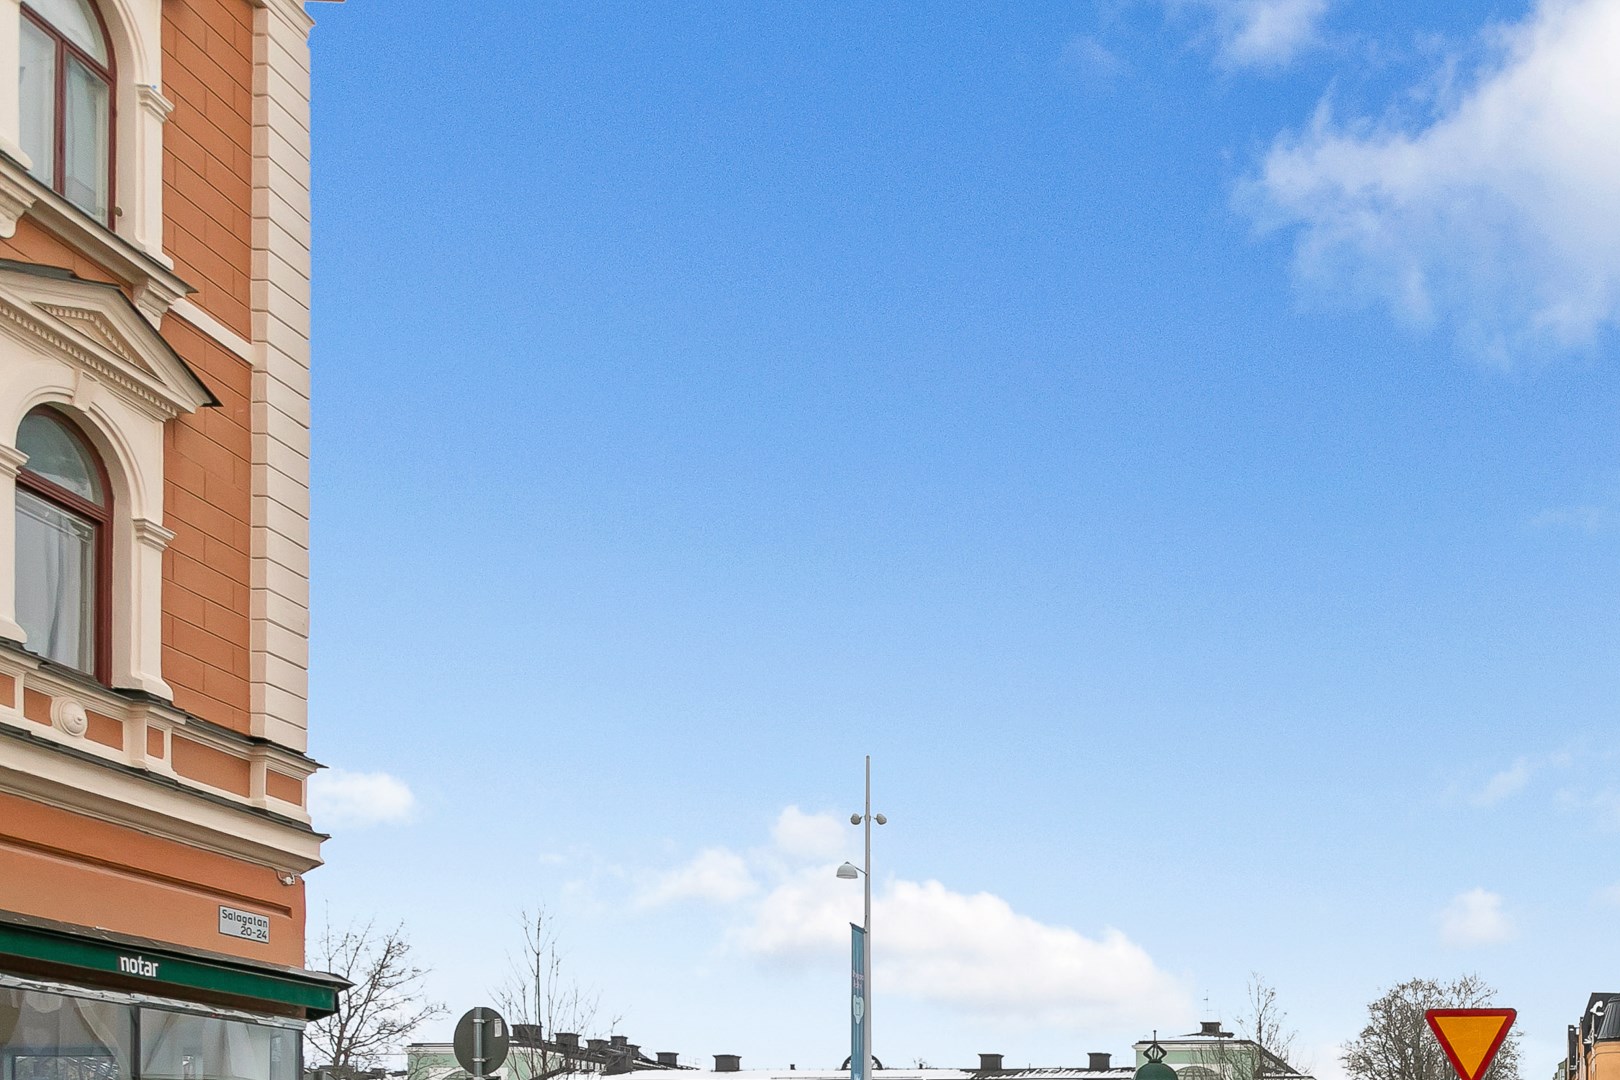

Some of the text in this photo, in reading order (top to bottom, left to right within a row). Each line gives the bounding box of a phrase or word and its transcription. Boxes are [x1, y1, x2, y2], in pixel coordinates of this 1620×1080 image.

[222, 909, 267, 928] Salagatan
[241, 925, 267, 940] 20-24
[120, 956, 159, 977] notar
